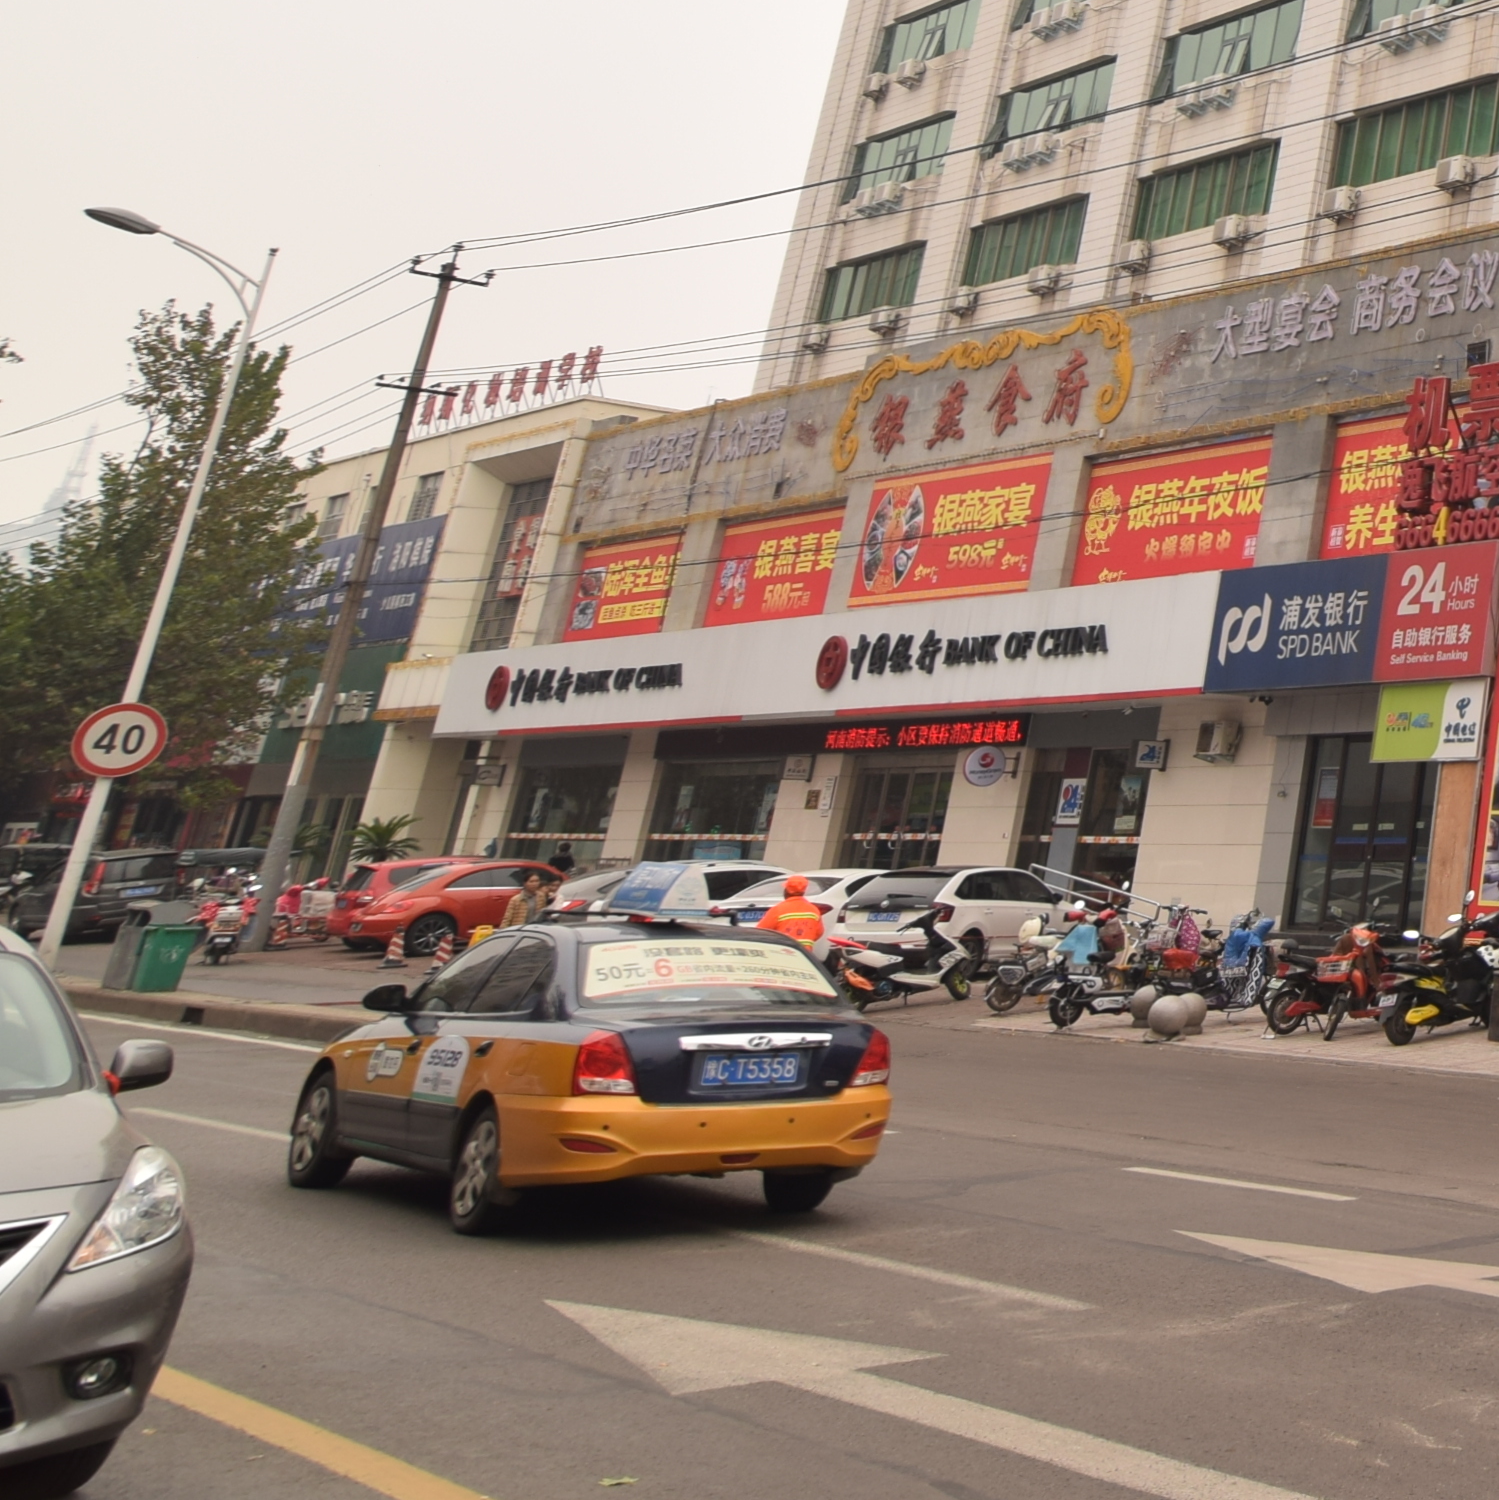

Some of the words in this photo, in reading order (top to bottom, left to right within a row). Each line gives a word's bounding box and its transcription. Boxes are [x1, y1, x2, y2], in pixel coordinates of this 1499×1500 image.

[1211, 283, 1341, 363] 大型宴会
[1350, 250, 1499, 336] 商务会议
[870, 348, 1090, 457] 银燕食府
[931, 482, 1036, 540] 银燕家宴
[1126, 463, 1269, 532] 银燕年夜饭
[753, 529, 842, 580] 银燕喜宴
[1396, 561, 1447, 616] 24
[1447, 597, 1475, 612] Hours
[1448, 574, 1480, 597] 小时
[1279, 589, 1369, 632] 浦发银行
[850, 629, 943, 681] 中国银行
[942, 634, 1002, 666] BANK
[1004, 630, 1035, 659] OF
[1037, 623, 1109, 658] CHINA
[1277, 632, 1310, 660] SPD
[1312, 629, 1361, 657] BANK
[1390, 653, 1406, 665] Self
[1406, 651, 1435, 664] Service
[1436, 649, 1468, 662] Banking
[1391, 623, 1473, 650] 自助银行服务
[92, 723, 146, 755] 40
[426, 1048, 463, 1068] 95128
